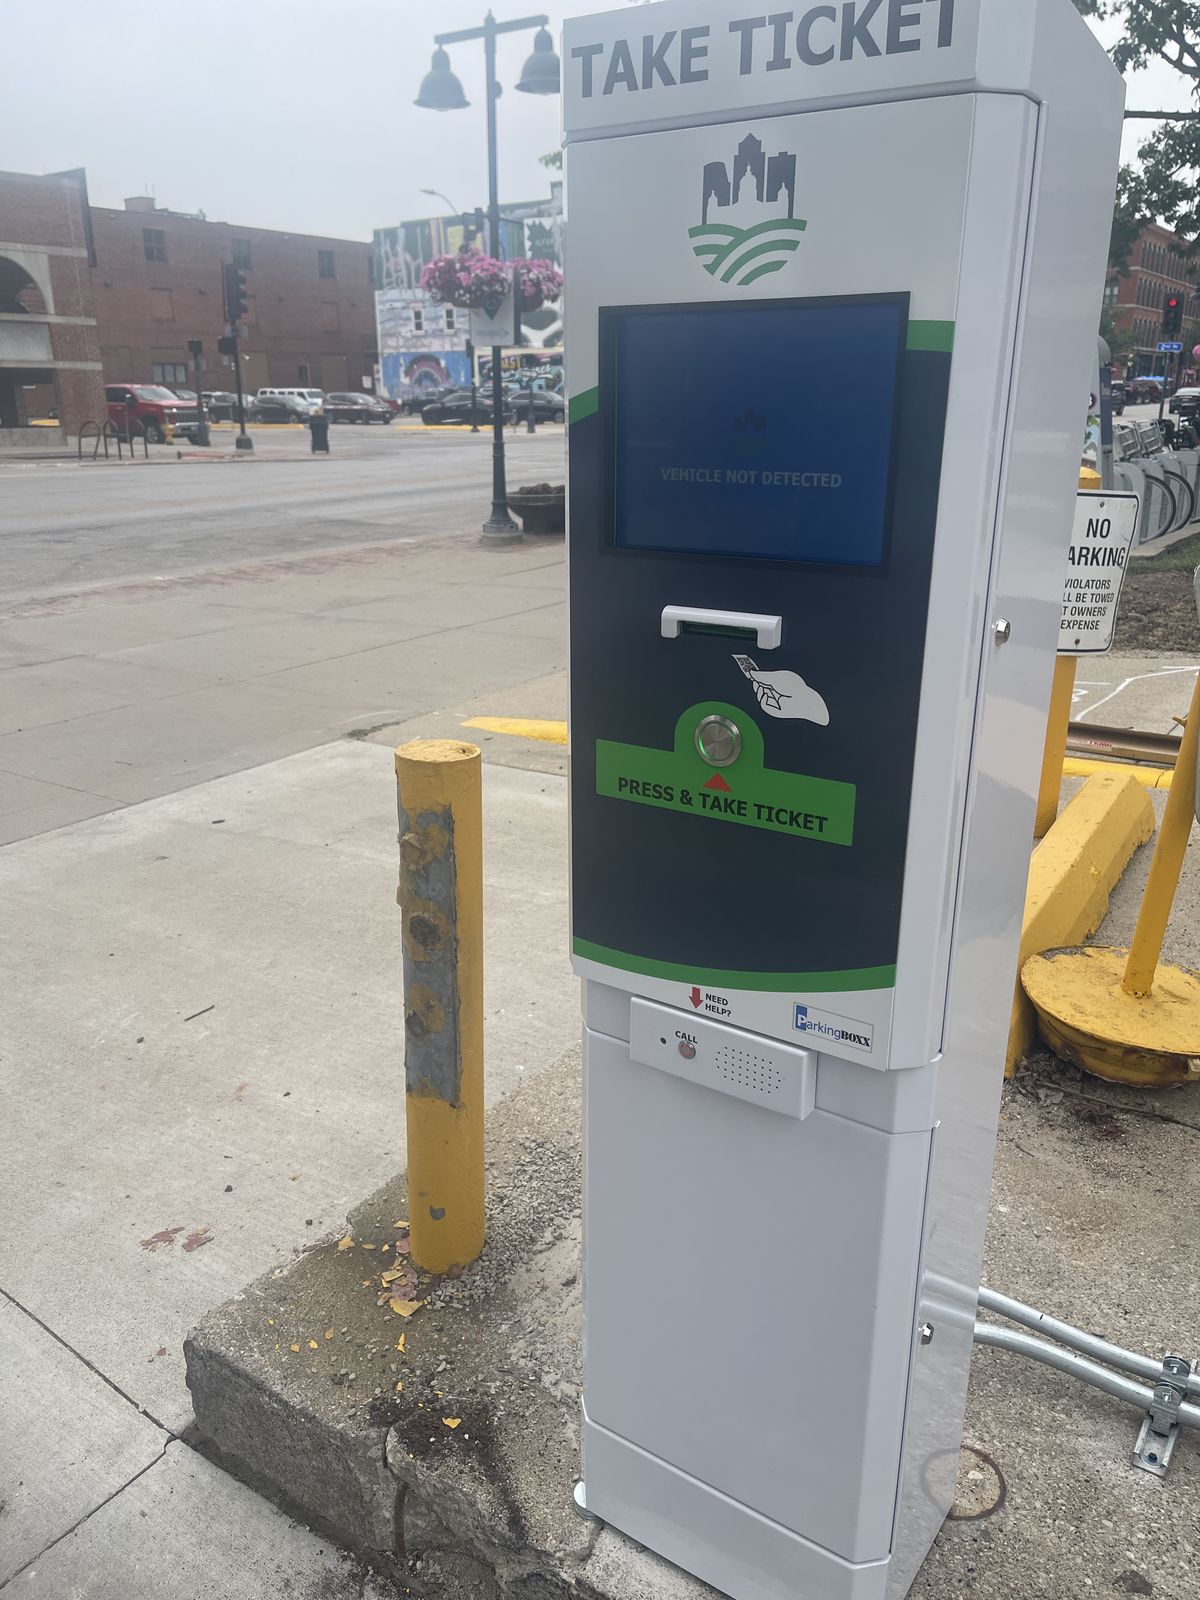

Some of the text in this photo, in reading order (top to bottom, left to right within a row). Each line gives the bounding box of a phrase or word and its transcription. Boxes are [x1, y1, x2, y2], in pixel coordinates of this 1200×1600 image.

[571, 0, 955, 98] TAKE TICKET
[660, 467, 842, 489] VEHICLE NOT DETECTED
[1086, 518, 1111, 539] NO
[1068, 545, 1126, 567] ARKING
[1064, 578, 1111, 590] VIOLATORS
[1075, 592, 1088, 603] BE
[1090, 592, 1115, 604] TOWED
[1061, 605, 1107, 617] T OWNERS
[1060, 619, 1101, 631] EXPENSE
[618, 776, 829, 834] PRESS & TAKE TICKET
[705, 993, 729, 1006] NEED
[705, 1003, 732, 1018] HELP?
[795, 1006, 871, 1048] ParkingBOXX
[675, 1030, 698, 1044] CALL
